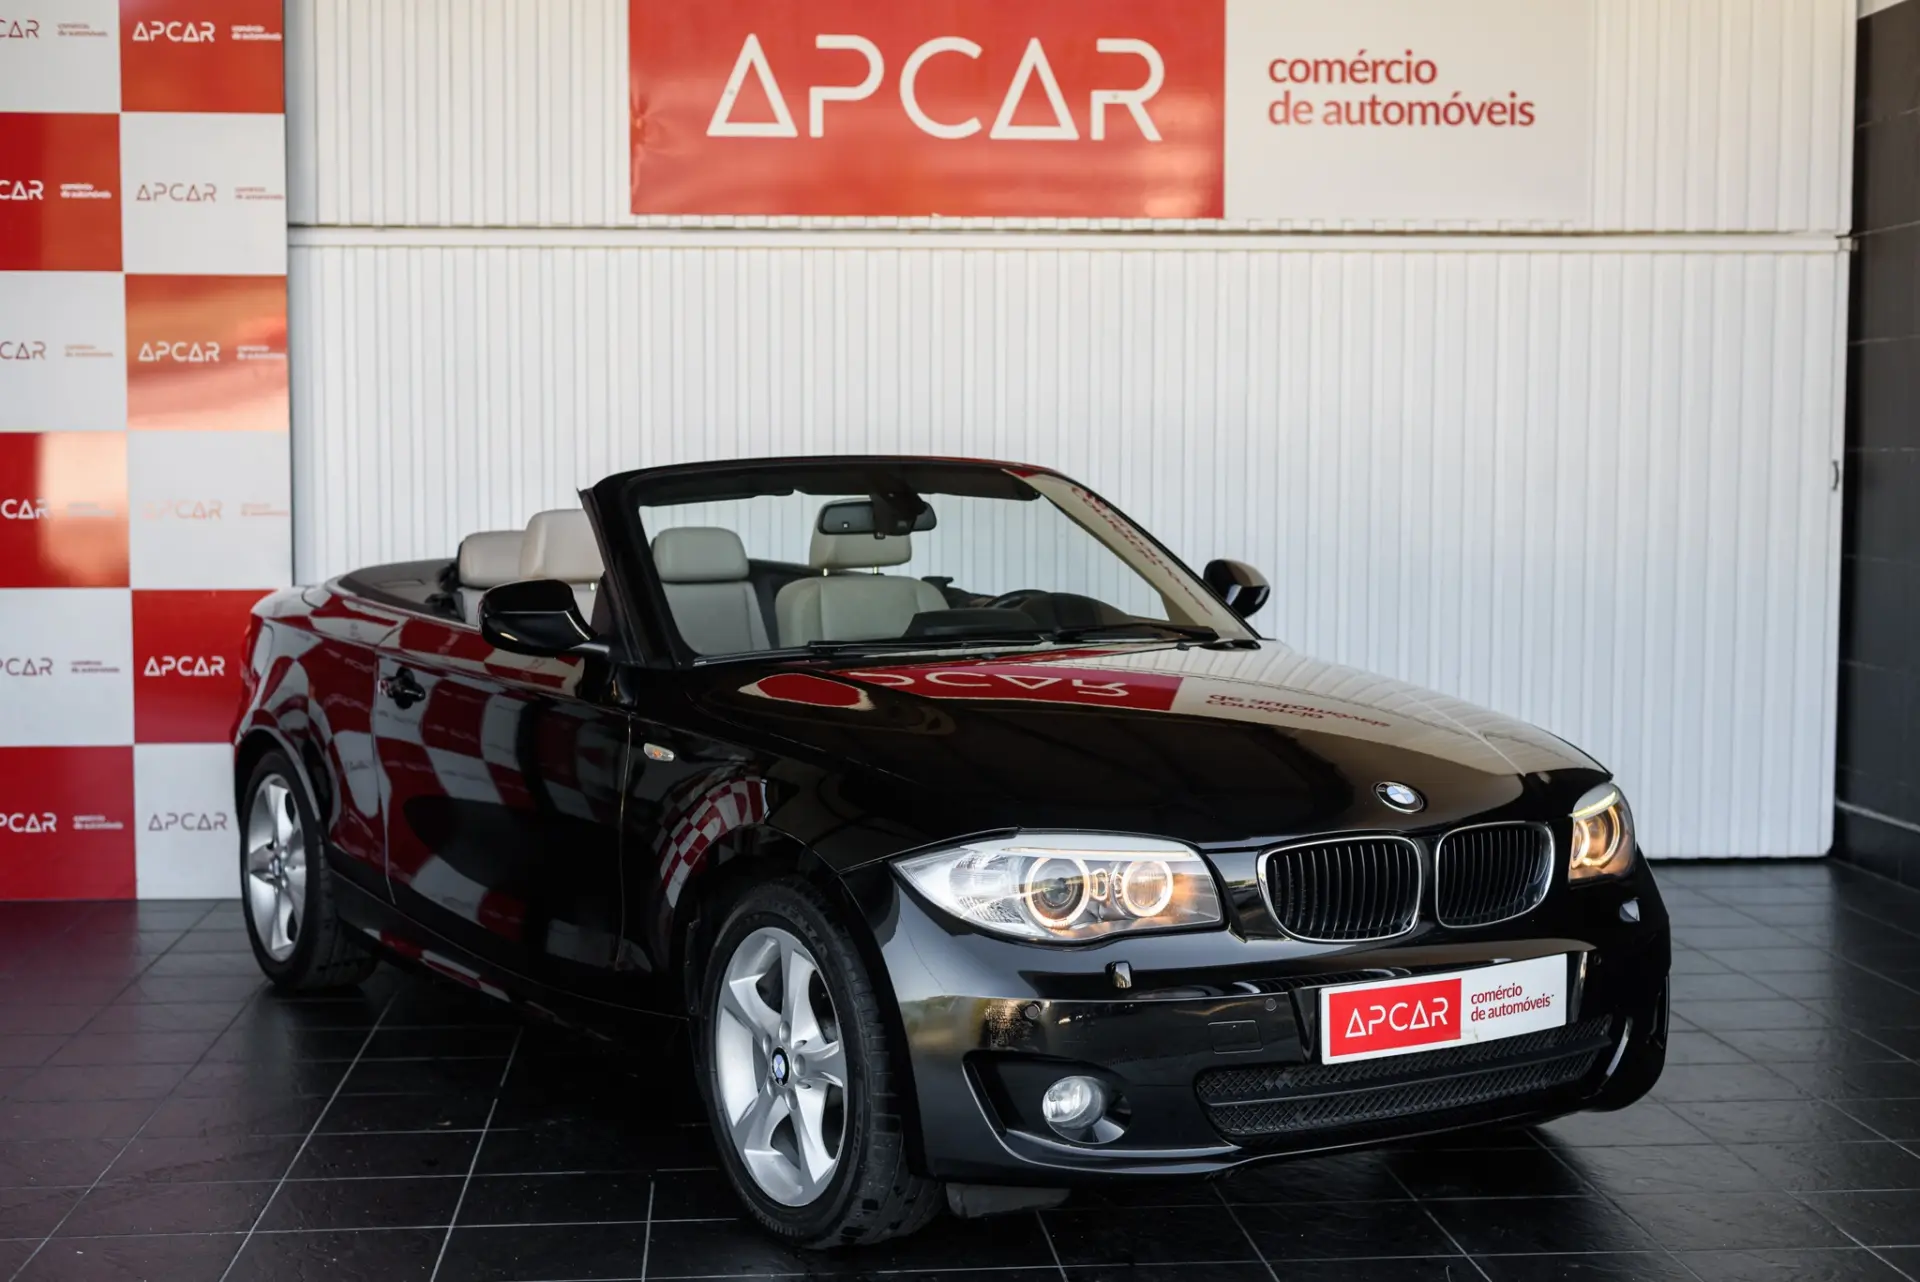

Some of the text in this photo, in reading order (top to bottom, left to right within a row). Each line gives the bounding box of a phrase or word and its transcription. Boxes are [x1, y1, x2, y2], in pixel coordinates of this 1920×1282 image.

[132, 21, 216, 43] APCAR
[1268, 49, 1438, 84] comércio
[706, 33, 1165, 142] APCAR
[1268, 90, 1536, 126] de automóveis
[136, 183, 217, 202] APCAR
[0, 341, 47, 360] CAR
[138, 342, 220, 362] APCAR
[0, 657, 53, 676] CAR
[143, 656, 226, 676] APCAR
[148, 812, 228, 831] APCAR
[1470, 982, 1523, 1005] comércio
[1345, 997, 1449, 1039] APCAR
[1470, 1006, 1486, 1022] de
